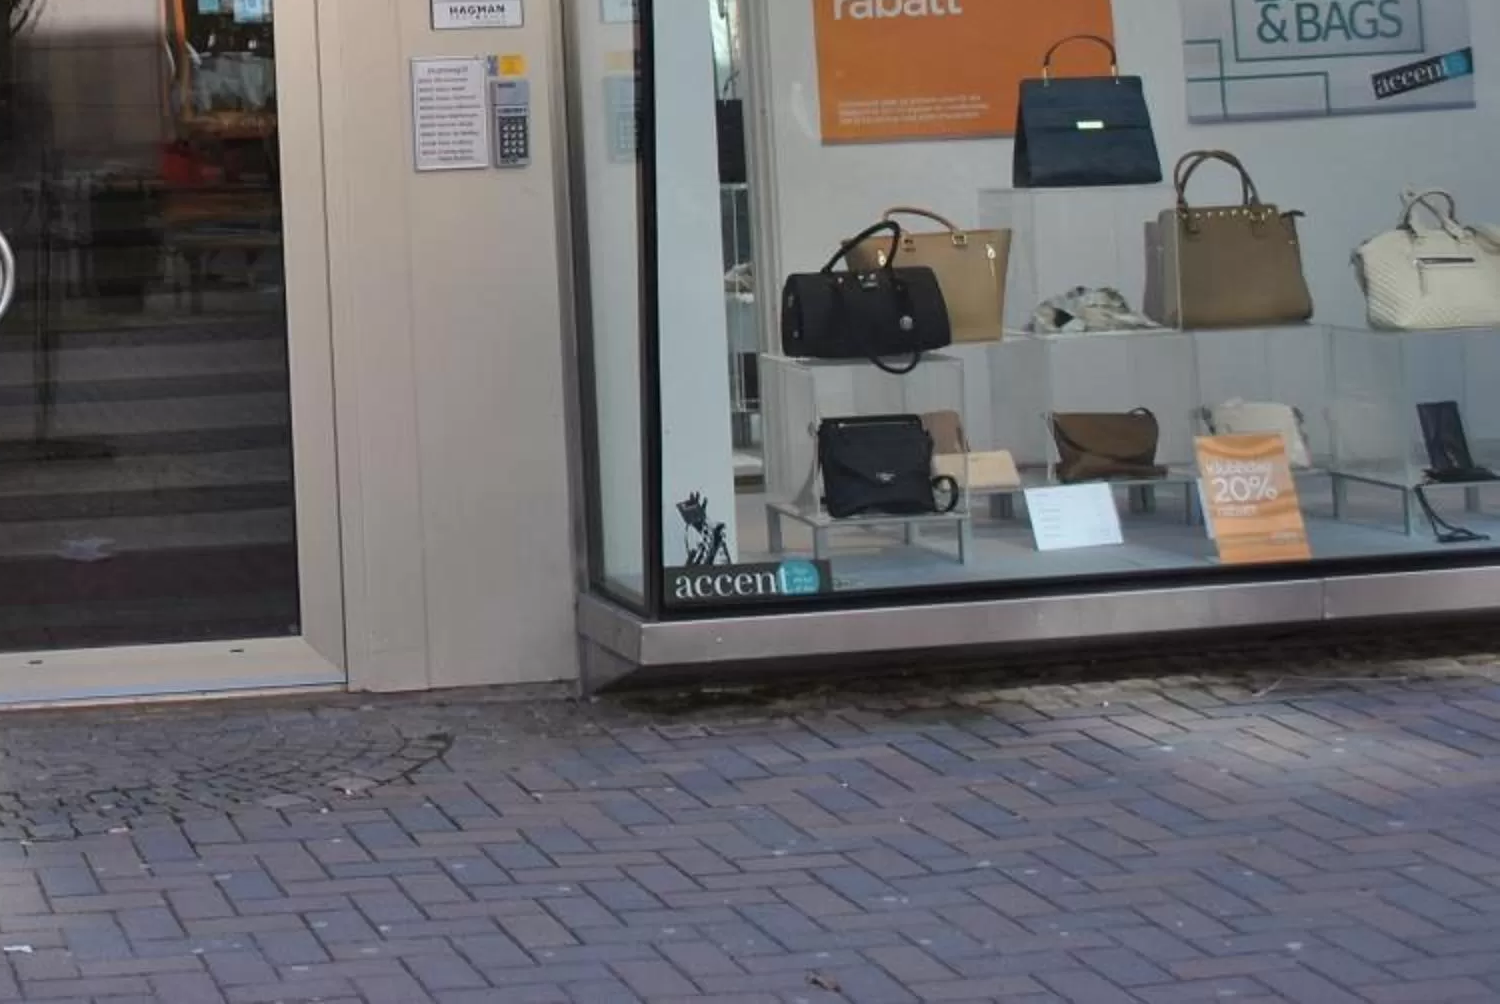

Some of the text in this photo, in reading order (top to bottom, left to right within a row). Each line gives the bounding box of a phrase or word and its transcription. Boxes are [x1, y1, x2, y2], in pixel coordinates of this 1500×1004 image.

[1256, 0, 1404, 44] & BAGS
[1211, 476, 1278, 503] 20%
[674, 565, 791, 599] accent
